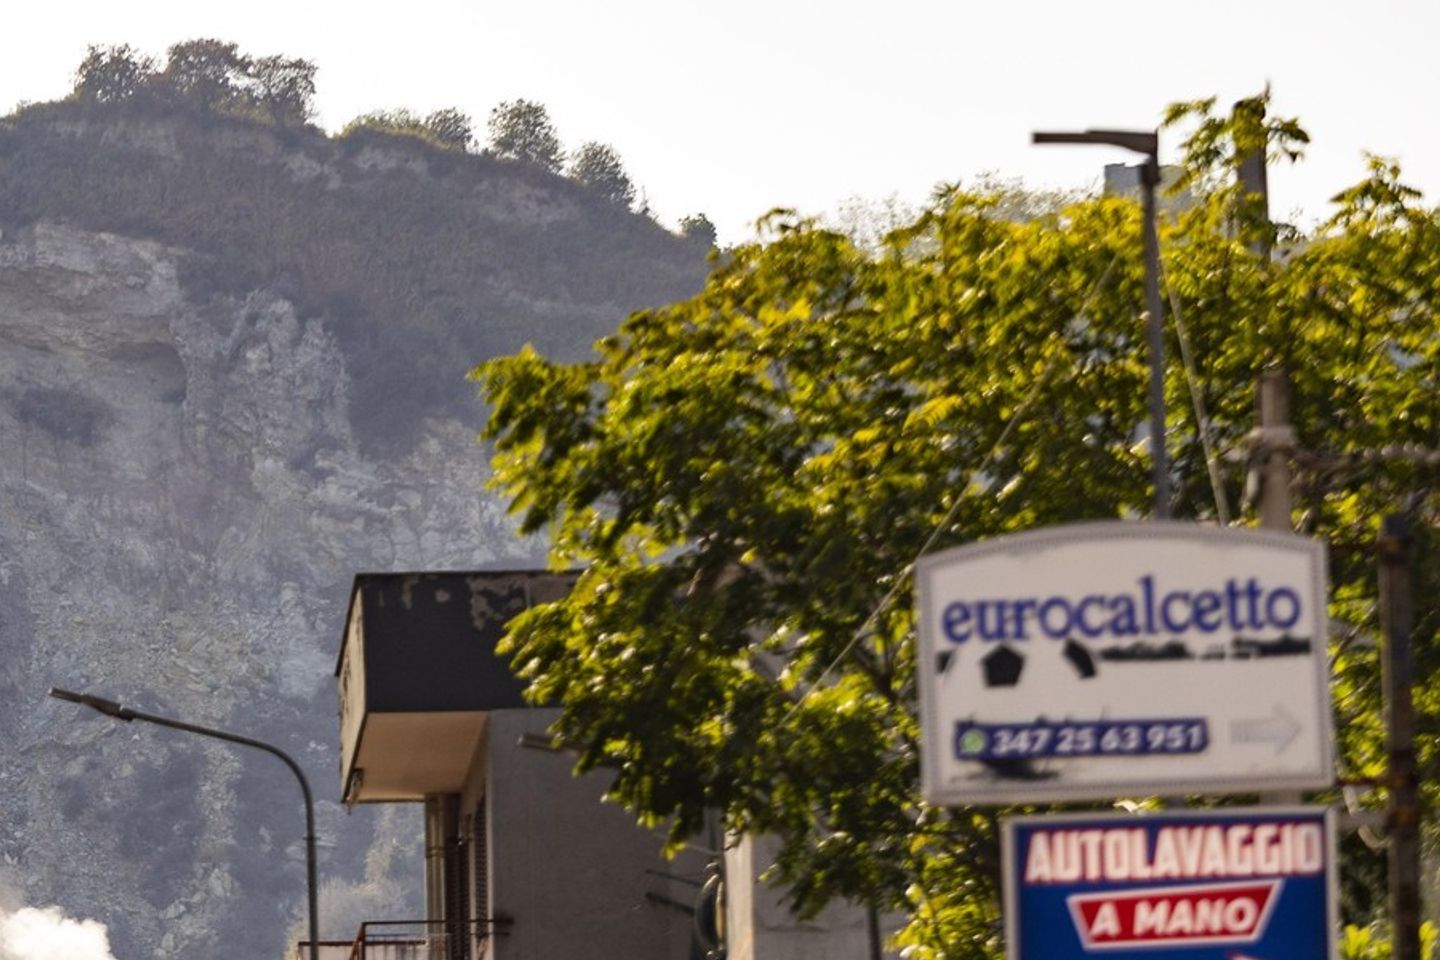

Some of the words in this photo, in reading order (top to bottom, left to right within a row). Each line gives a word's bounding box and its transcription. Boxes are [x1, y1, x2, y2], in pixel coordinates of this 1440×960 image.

[941, 575, 1303, 644] eurocalcetto
[991, 729, 1049, 756] 347
[1058, 728, 1090, 753] 25
[1100, 726, 1138, 751] 63
[1146, 723, 1204, 750] 951
[1024, 822, 1323, 883] AUTOLAVAGGIO
[1089, 902, 1122, 937] A
[1132, 896, 1260, 936] MANO
